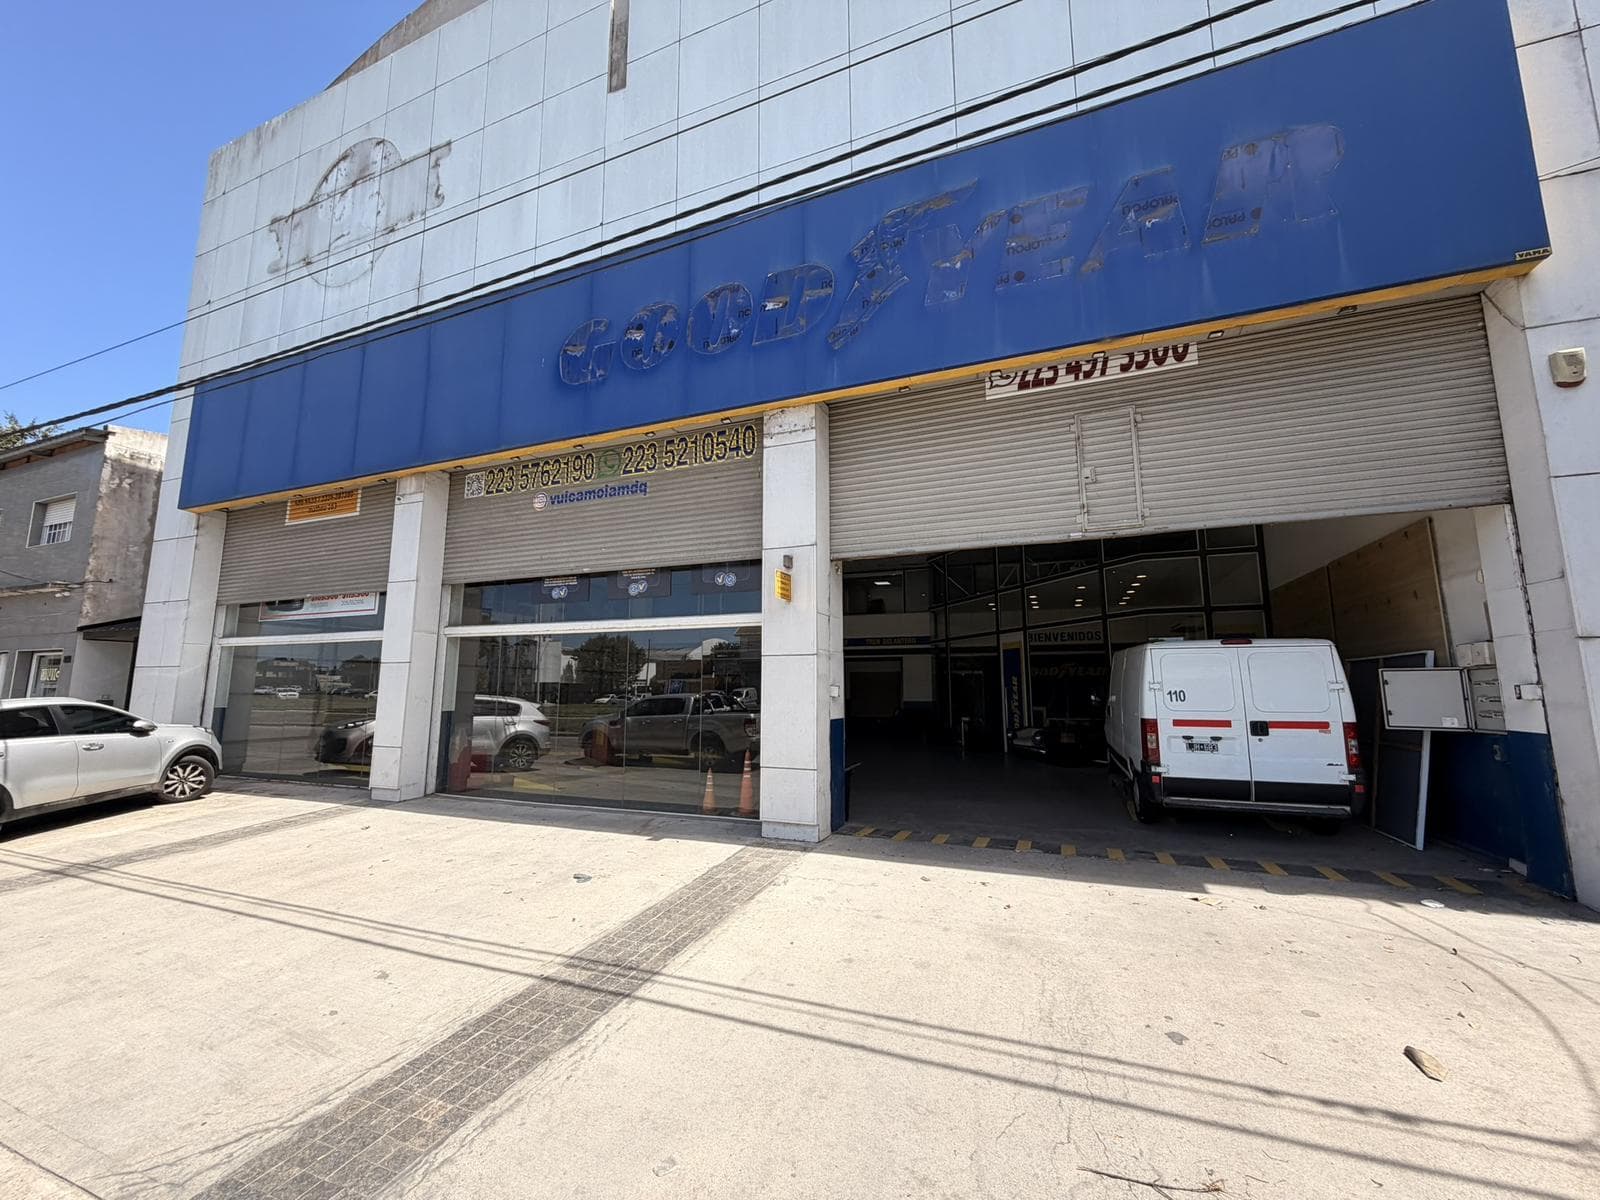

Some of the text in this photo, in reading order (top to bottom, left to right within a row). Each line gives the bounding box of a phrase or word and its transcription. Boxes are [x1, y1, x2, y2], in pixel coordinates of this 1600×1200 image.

[621, 424, 757, 476] 223 5210540
[486, 452, 595, 495] 223 5762190
[1028, 631, 1102, 642] BIENVENIDOS
[1166, 689, 1187, 703] 110
